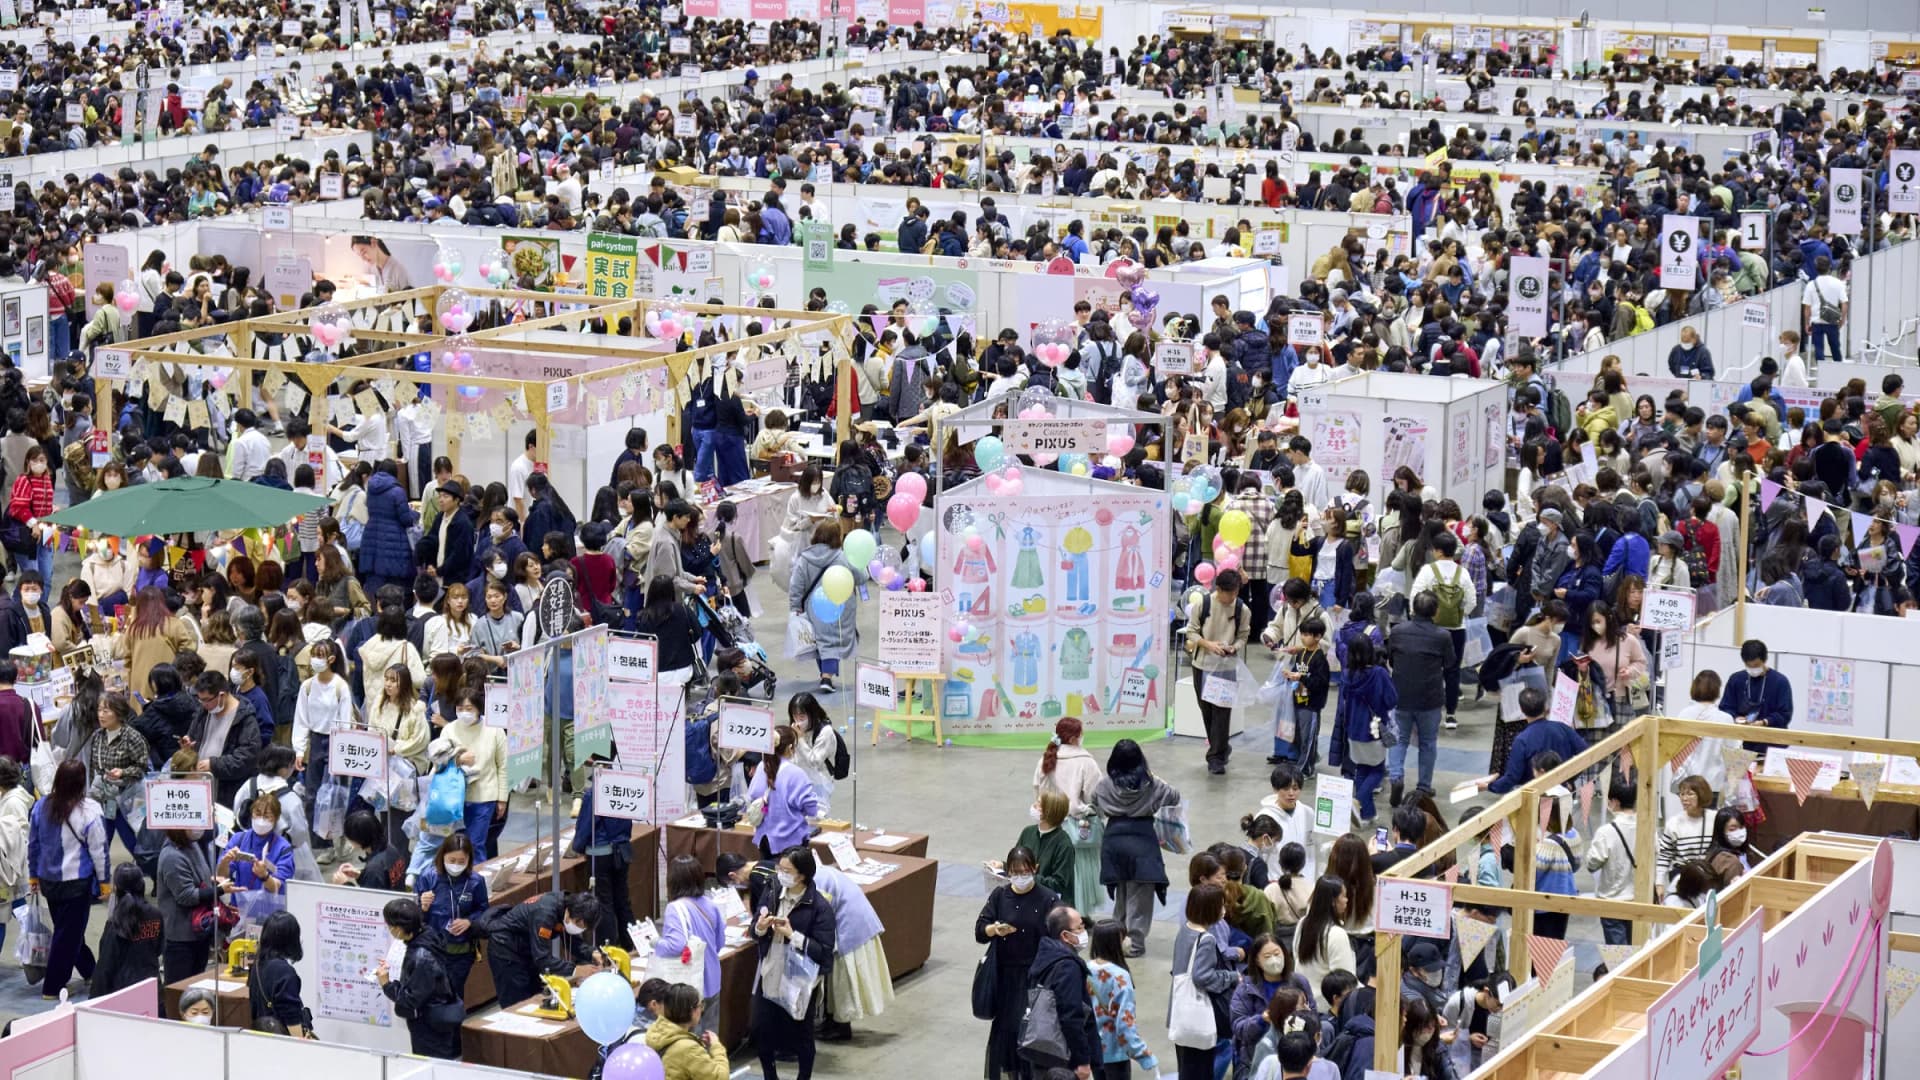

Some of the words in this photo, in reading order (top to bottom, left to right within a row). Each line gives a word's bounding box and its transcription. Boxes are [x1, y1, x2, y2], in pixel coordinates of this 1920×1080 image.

[1747, 223, 1759, 241] 1
[543, 366, 573, 378] PIXUS
[1034, 438, 1077, 449] PIXUS
[894, 609, 925, 618] PIXUS
[1664, 643, 1679, 658] 出口
[343, 758, 372, 771] マシーン
[167, 789, 191, 800] H-06
[165, 803, 190, 811] ときめき
[609, 799, 638, 812] マシーン
[1400, 890, 1428, 902] H-15
[1393, 914, 1433, 928] 株式会社
